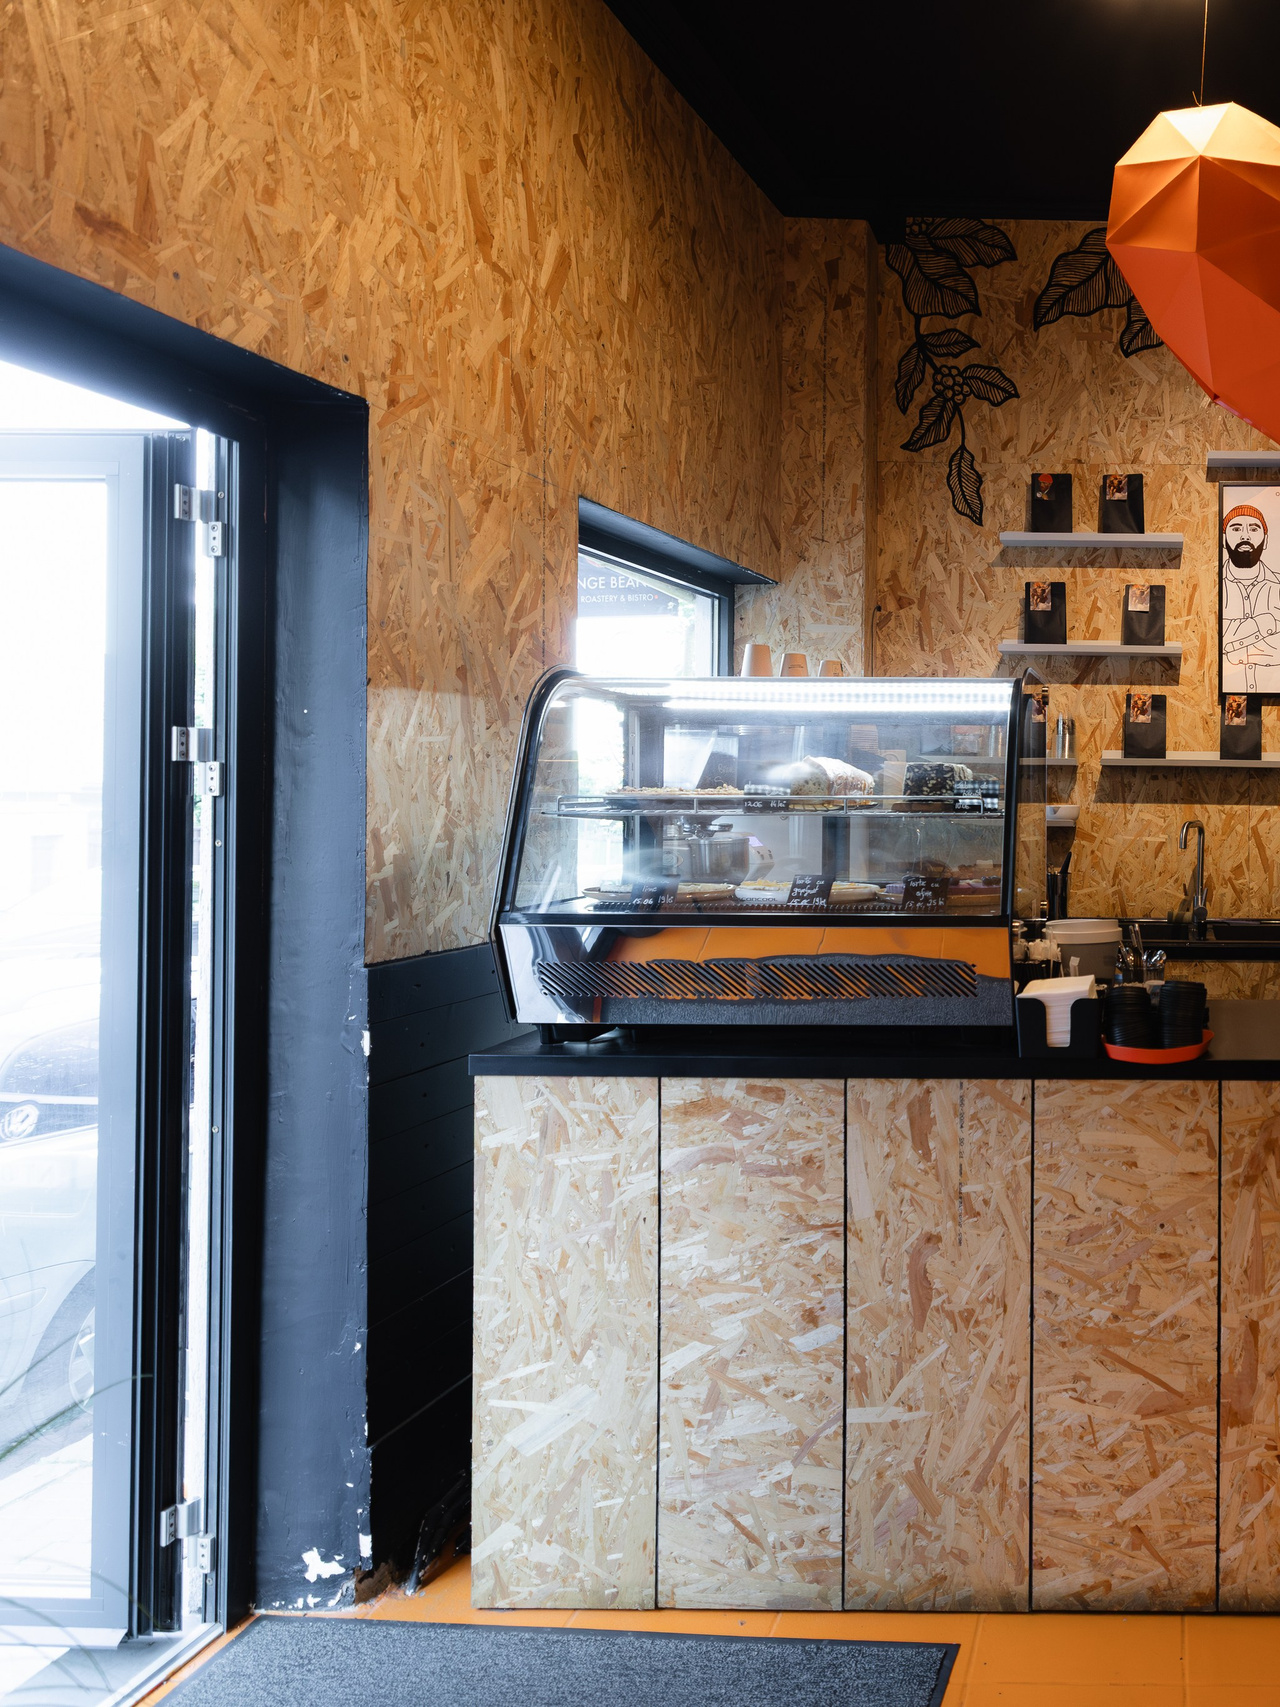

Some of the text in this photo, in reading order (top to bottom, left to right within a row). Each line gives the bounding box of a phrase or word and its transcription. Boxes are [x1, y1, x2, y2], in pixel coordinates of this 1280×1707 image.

[578, 576, 649, 590] NGE BEAN
[580, 595, 618, 603] ROASTERY
[627, 594, 654, 602] BISTRO
